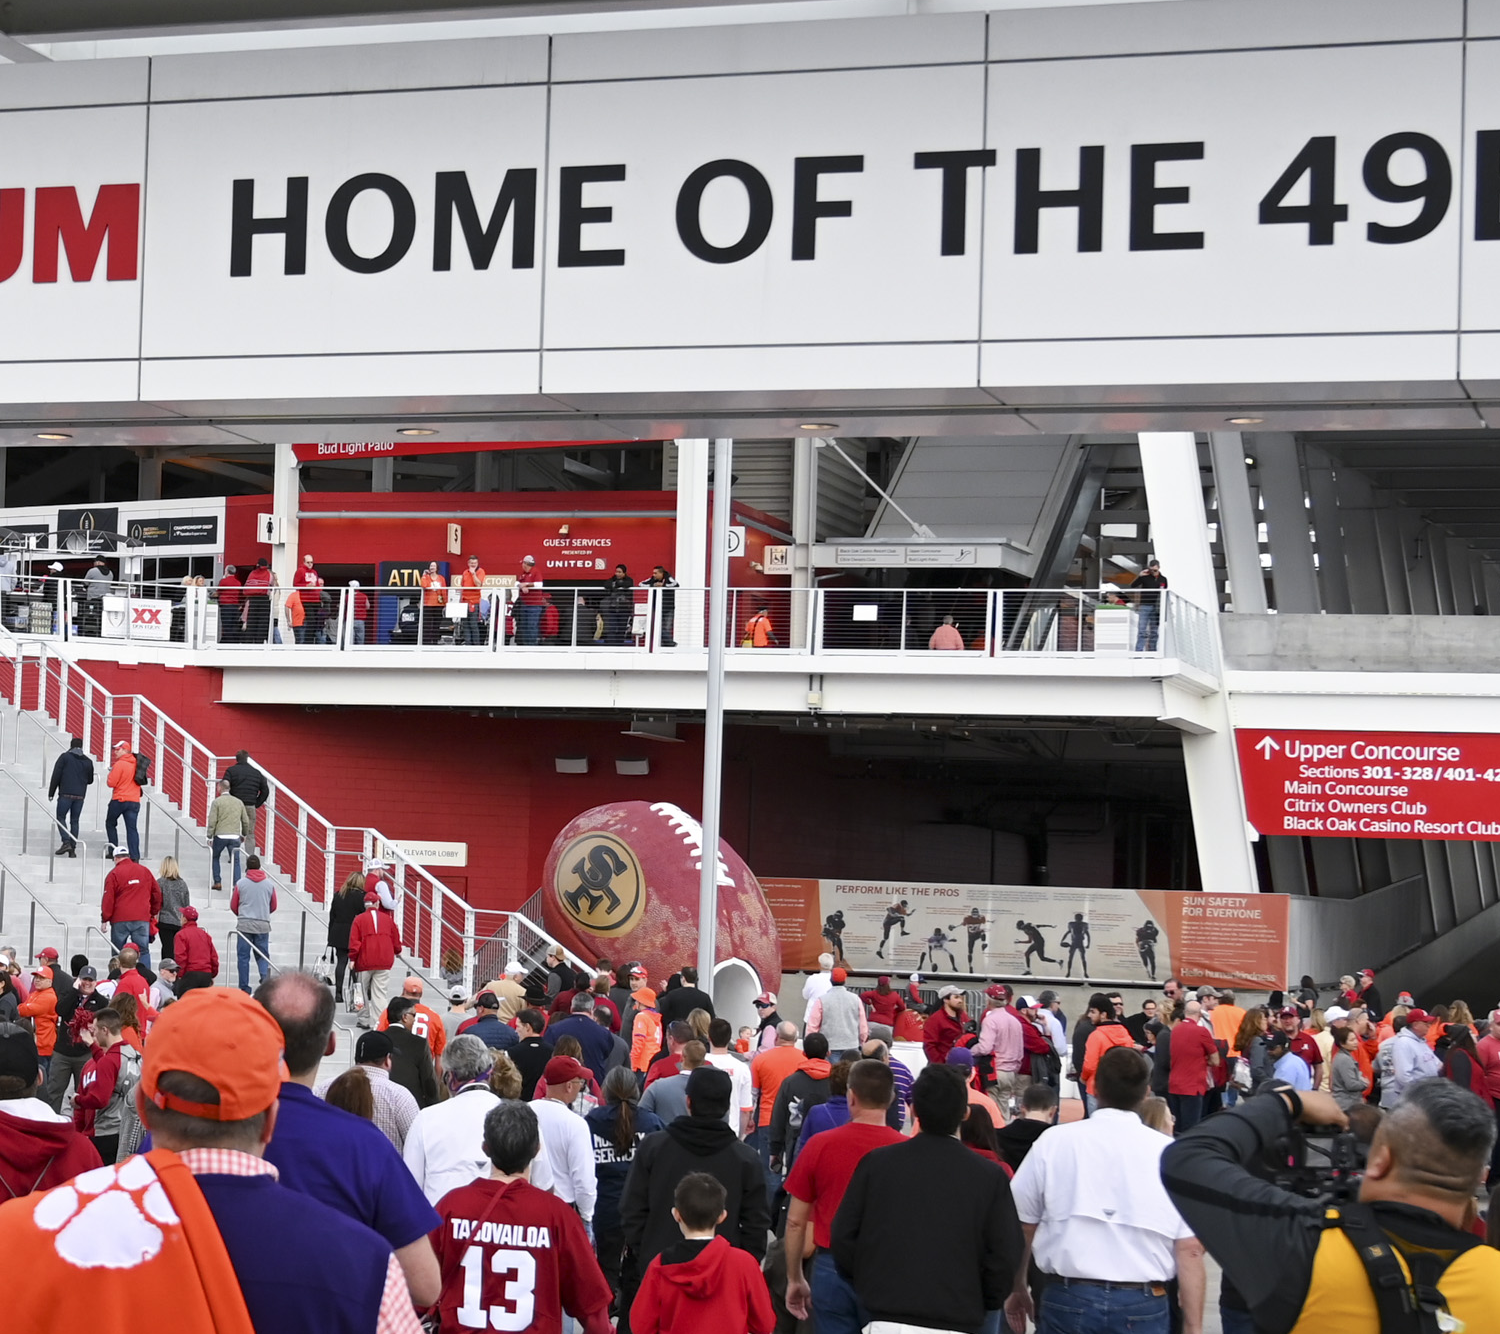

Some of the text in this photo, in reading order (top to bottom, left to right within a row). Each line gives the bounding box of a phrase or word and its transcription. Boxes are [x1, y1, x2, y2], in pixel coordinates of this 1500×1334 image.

[228, 161, 628, 279] HOME
[674, 154, 866, 266] OF
[913, 141, 1207, 258] THE
[318, 442, 394, 456] Bud Light Patio
[543, 538, 612, 547] GUEST SERVICES
[546, 560, 593, 568] UNITED
[131, 608, 162, 625] XX
[1284, 740, 1461, 763] Upper Concourse
[1298, 764, 1360, 779] Sections
[1283, 780, 1409, 797] Main Concourse
[1283, 798, 1427, 815] Citrix Owners Club
[1283, 816, 1324, 831] Black
[1326, 817, 1357, 832] Oak
[1359, 818, 1411, 833] Casino
[1413, 820, 1465, 834] Resort
[404, 848, 459, 858] ELEVATOR LOBBY
[835, 884, 884, 895] PERFORM
[885, 886, 908, 896] LIKE
[910, 887, 931, 896] THE
[933, 888, 960, 898] PROS
[1182, 896, 1248, 907] SUN SAFETY
[1182, 907, 1262, 919] FOR EVERYONE
[1180, 967, 1204, 978] Hello
[456, 1245, 537, 1332] 13
